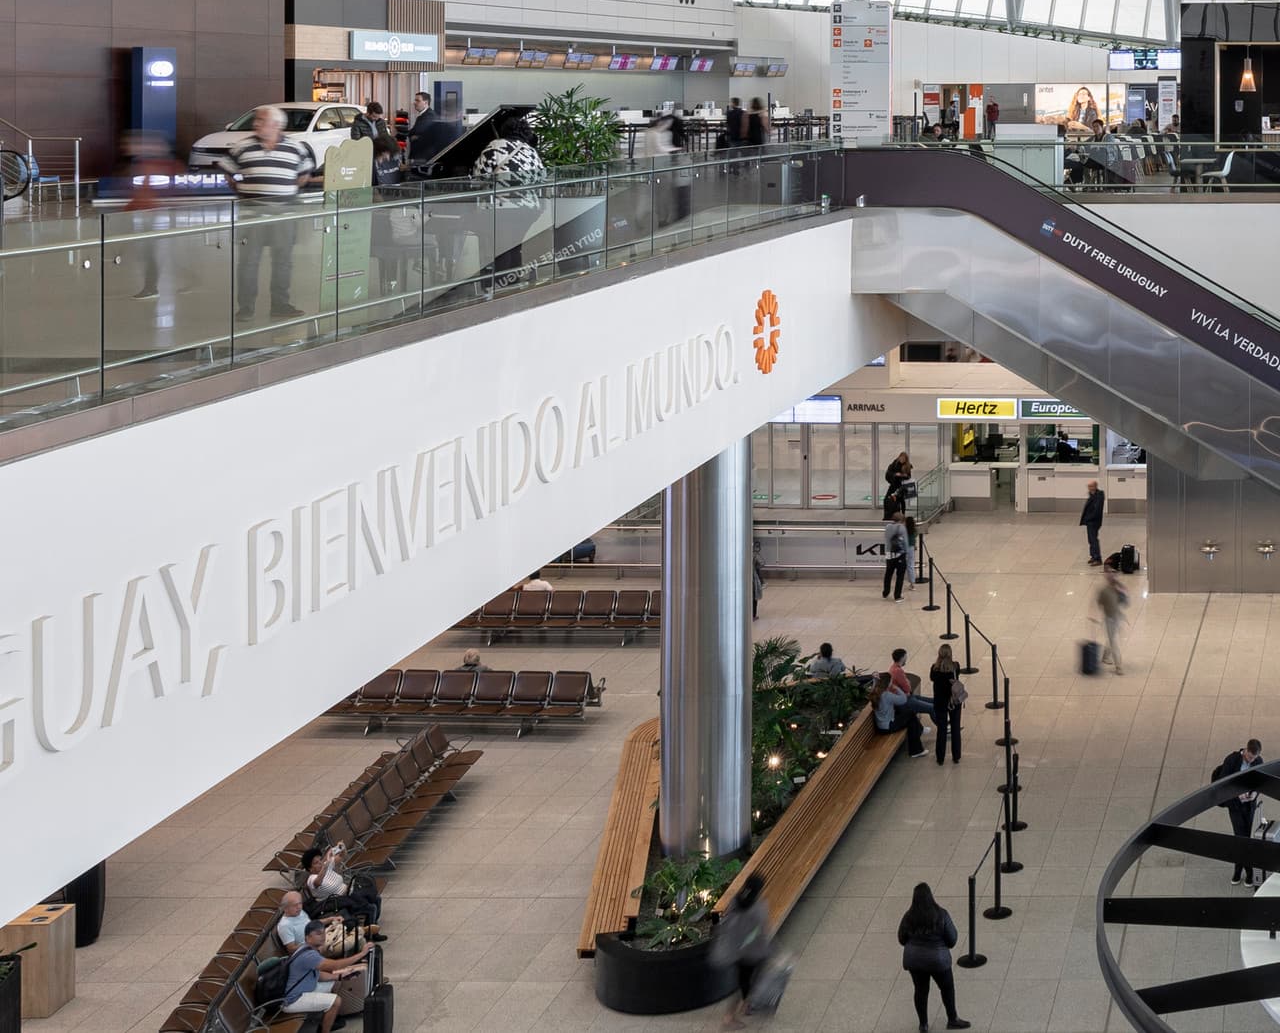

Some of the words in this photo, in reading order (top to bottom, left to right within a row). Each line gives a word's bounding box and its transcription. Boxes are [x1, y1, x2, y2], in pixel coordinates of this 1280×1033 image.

[1063, 232, 1092, 254] DUTY
[1091, 248, 1117, 269] FREE
[1117, 264, 1168, 298] URUGUAY
[1191, 308, 1218, 330] VIVÍ
[1214, 323, 1230, 340] LA
[847, 403, 886, 412] ARRIVALS
[954, 401, 998, 415] Hertz
[248, 397, 566, 646] BIENVENIDO
[574, 375, 619, 469] AL
[625, 323, 740, 440] MUNDO.
